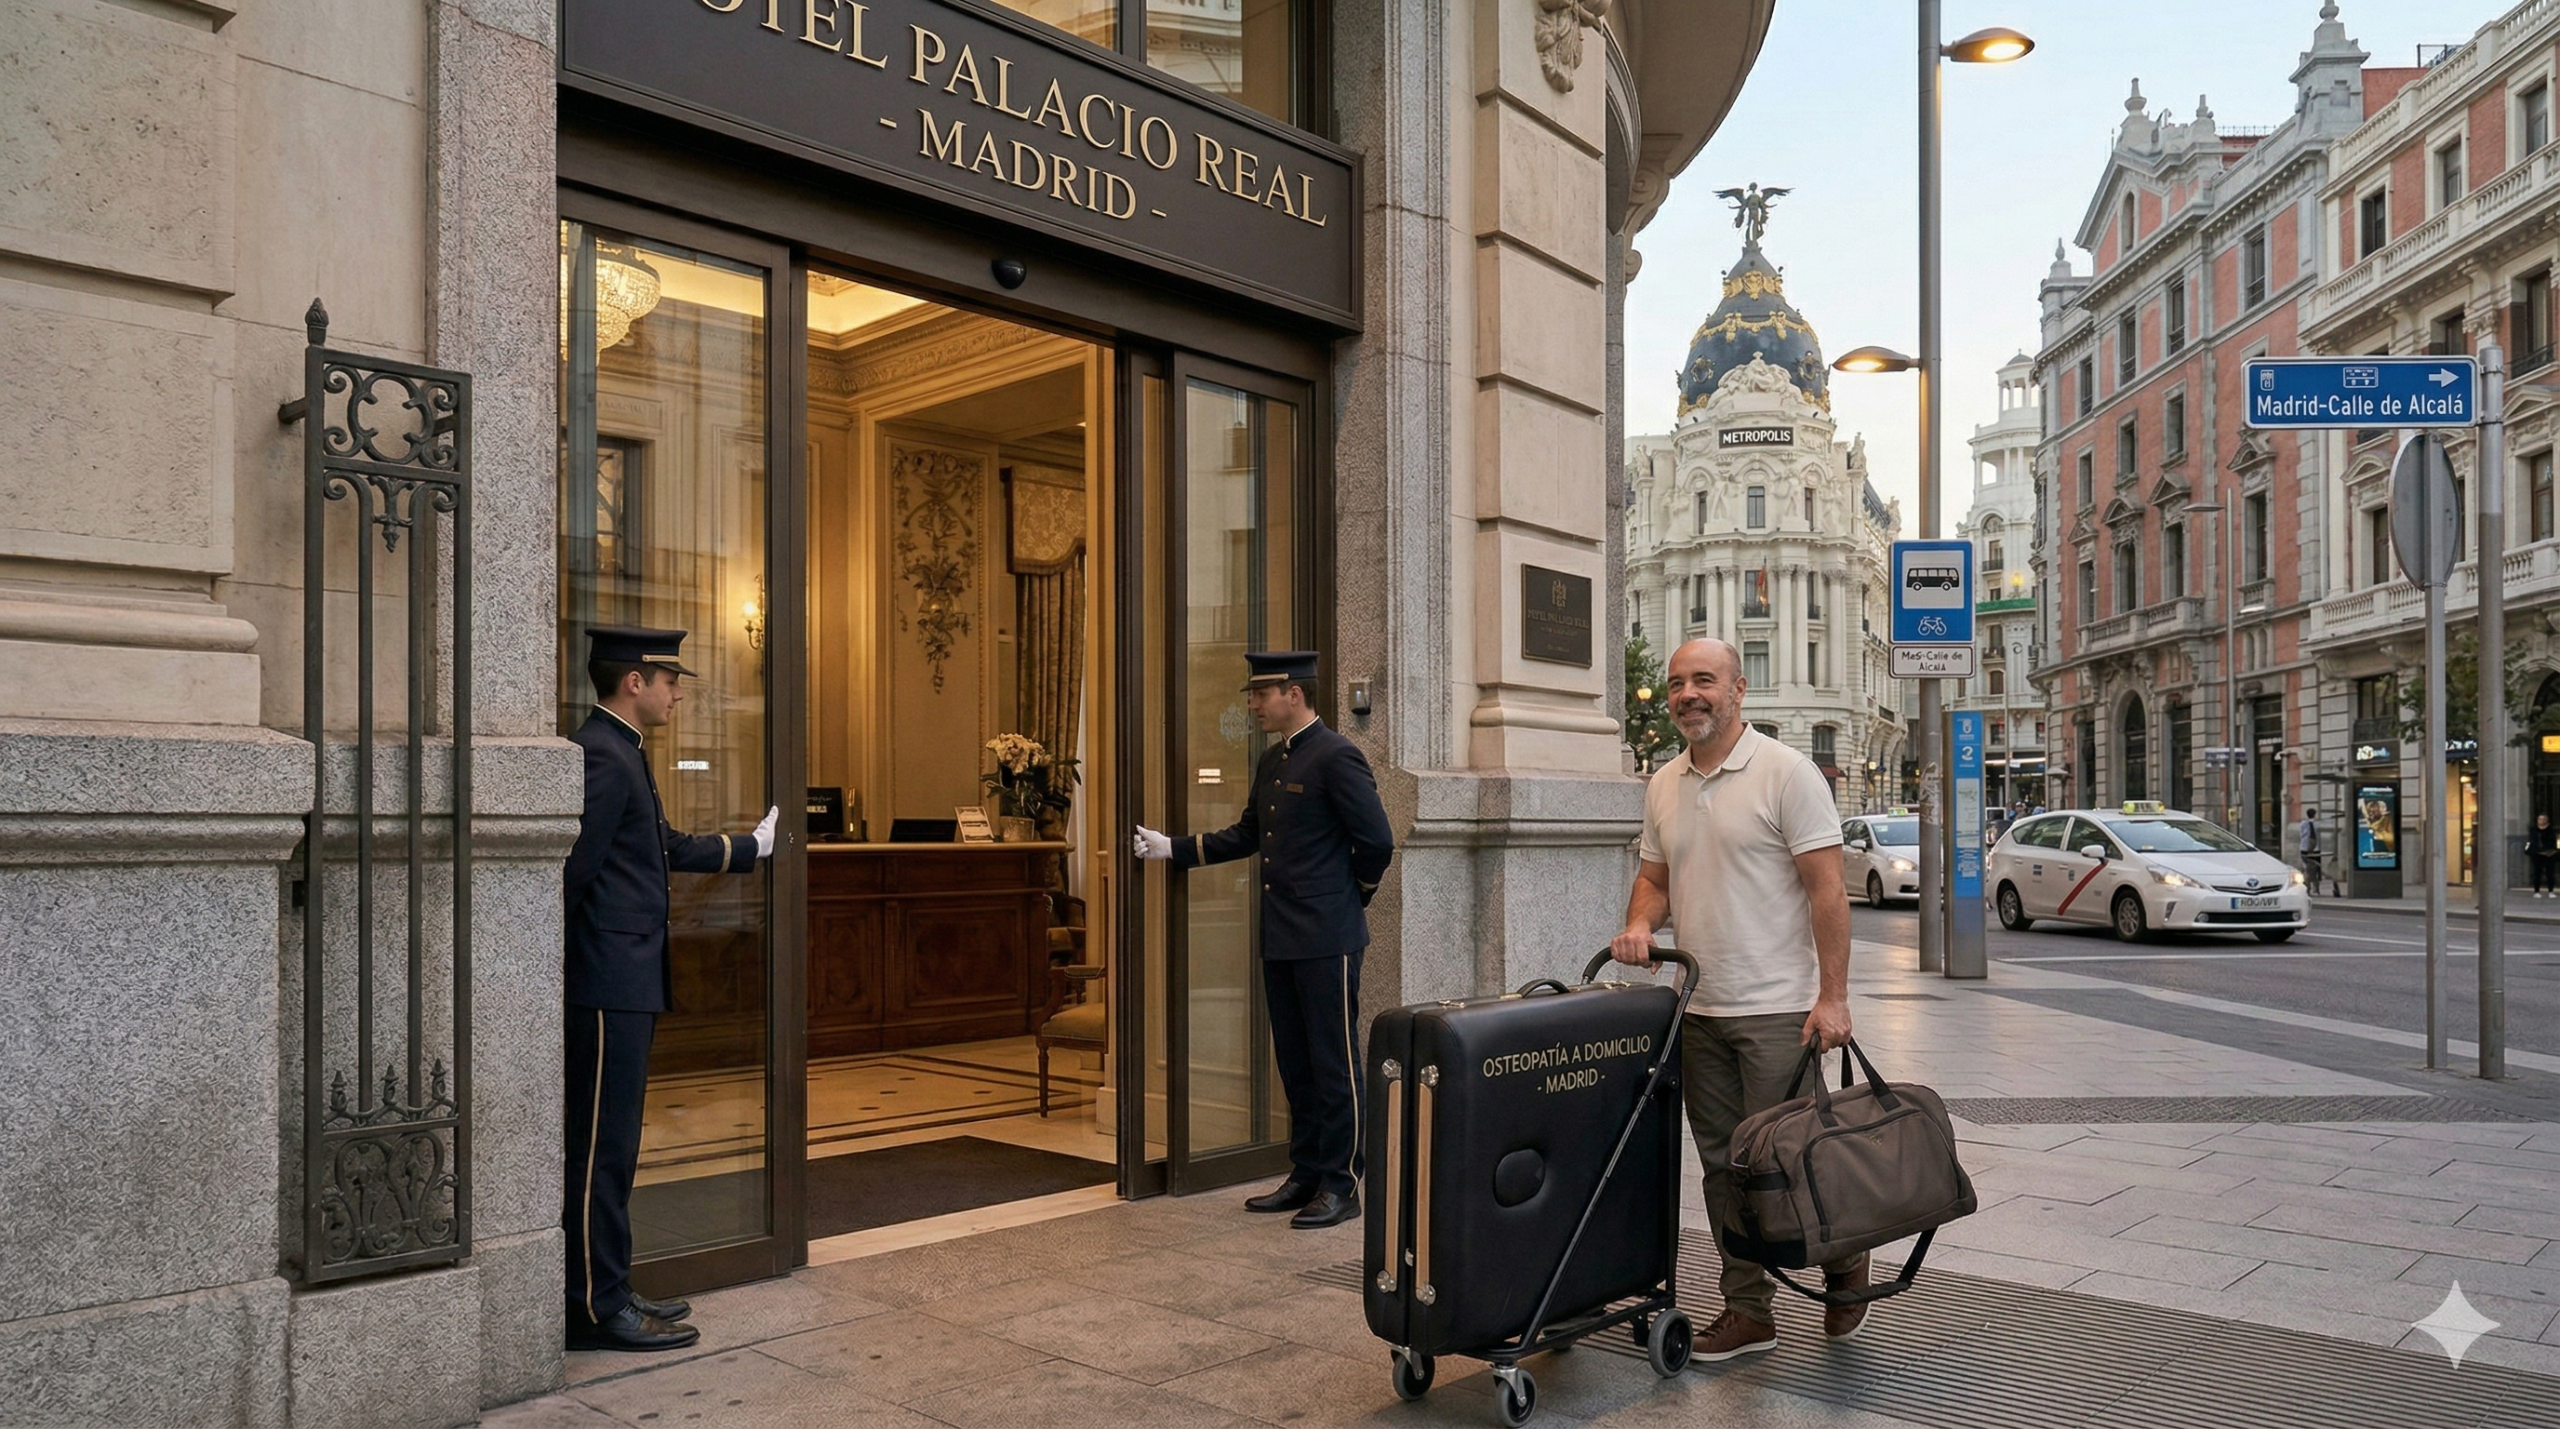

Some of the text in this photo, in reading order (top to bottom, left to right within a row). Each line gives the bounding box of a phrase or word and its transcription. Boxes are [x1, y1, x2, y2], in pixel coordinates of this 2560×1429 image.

[701, 0, 1327, 227] EL PALACIO REAL
[918, 108, 1137, 220] MADRID
[2257, 393, 2463, 416] Madrid-Calle de Alcalá
[1722, 430, 1791, 444] METROPOLIS
[1962, 746, 1973, 761] 2
[1482, 1034, 1651, 1078] OSTEOPATÍA A DOMICILIO
[1546, 1068, 1599, 1094] MADRID
